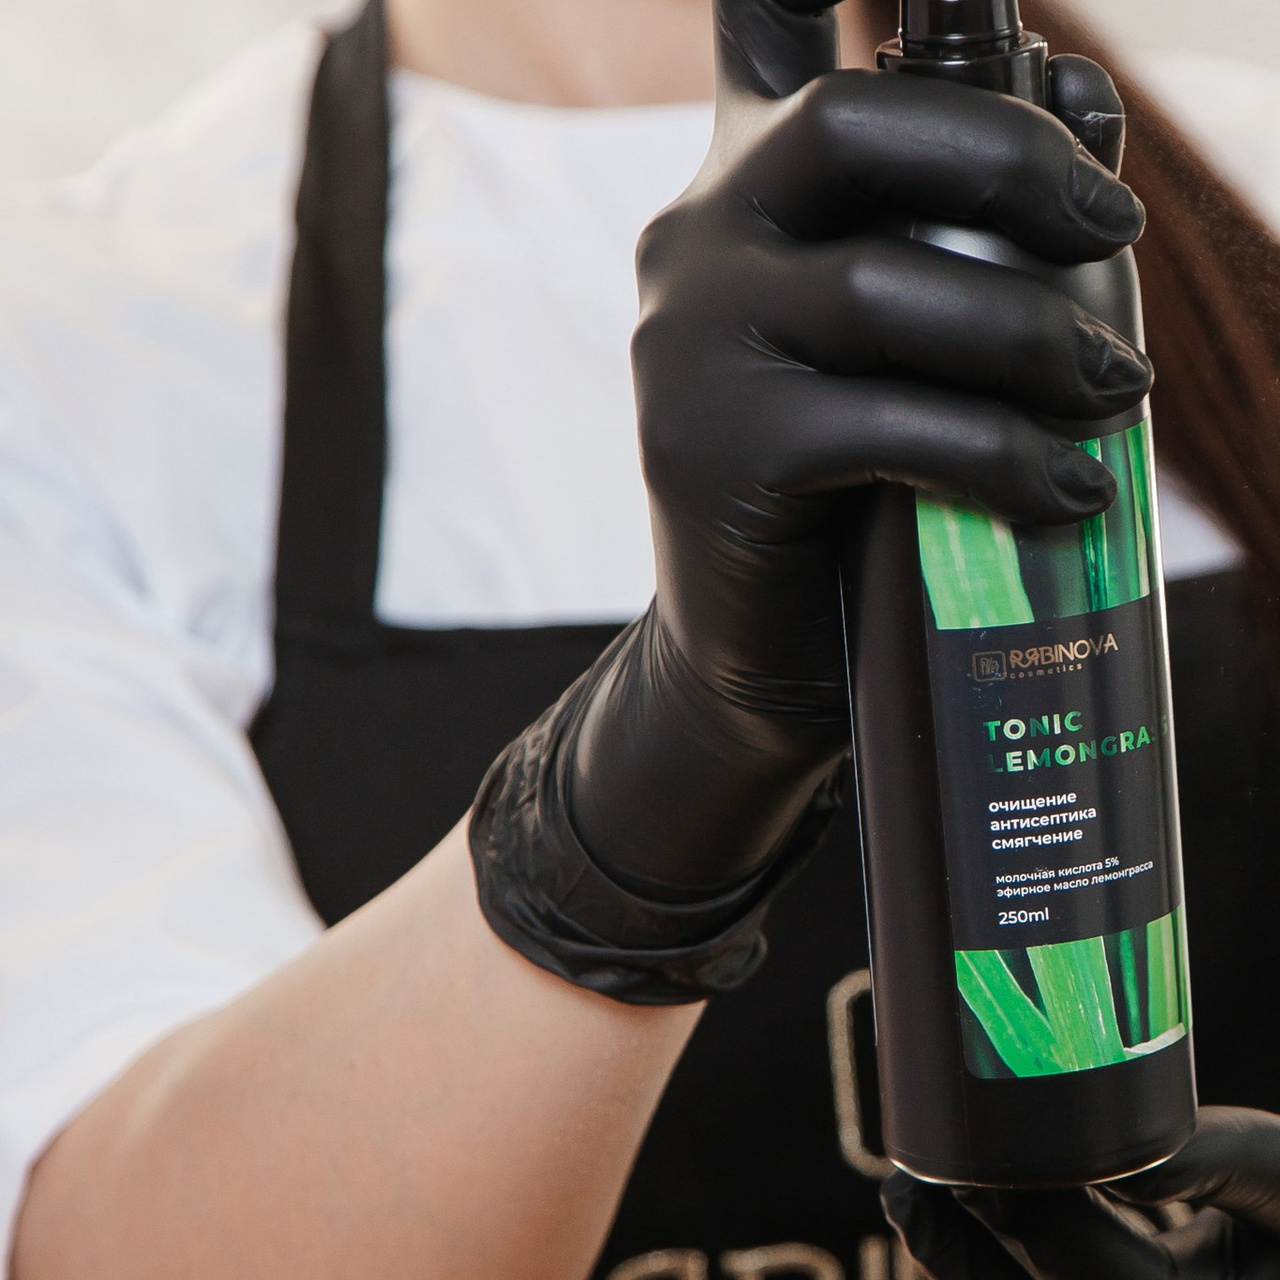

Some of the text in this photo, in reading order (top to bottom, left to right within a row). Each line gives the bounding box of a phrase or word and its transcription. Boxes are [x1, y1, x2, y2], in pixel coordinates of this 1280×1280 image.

[1010, 662, 1083, 679] cosmetics
[983, 710, 1083, 741] TONIC
[988, 792, 1077, 813] очищение
[990, 807, 1097, 831] антисептика
[992, 829, 1084, 850] смягчение
[995, 856, 1120, 884] молочная кислота 5%
[996, 860, 1154, 898] эфирное масло лемонграсса
[998, 907, 1050, 925] 250ml
